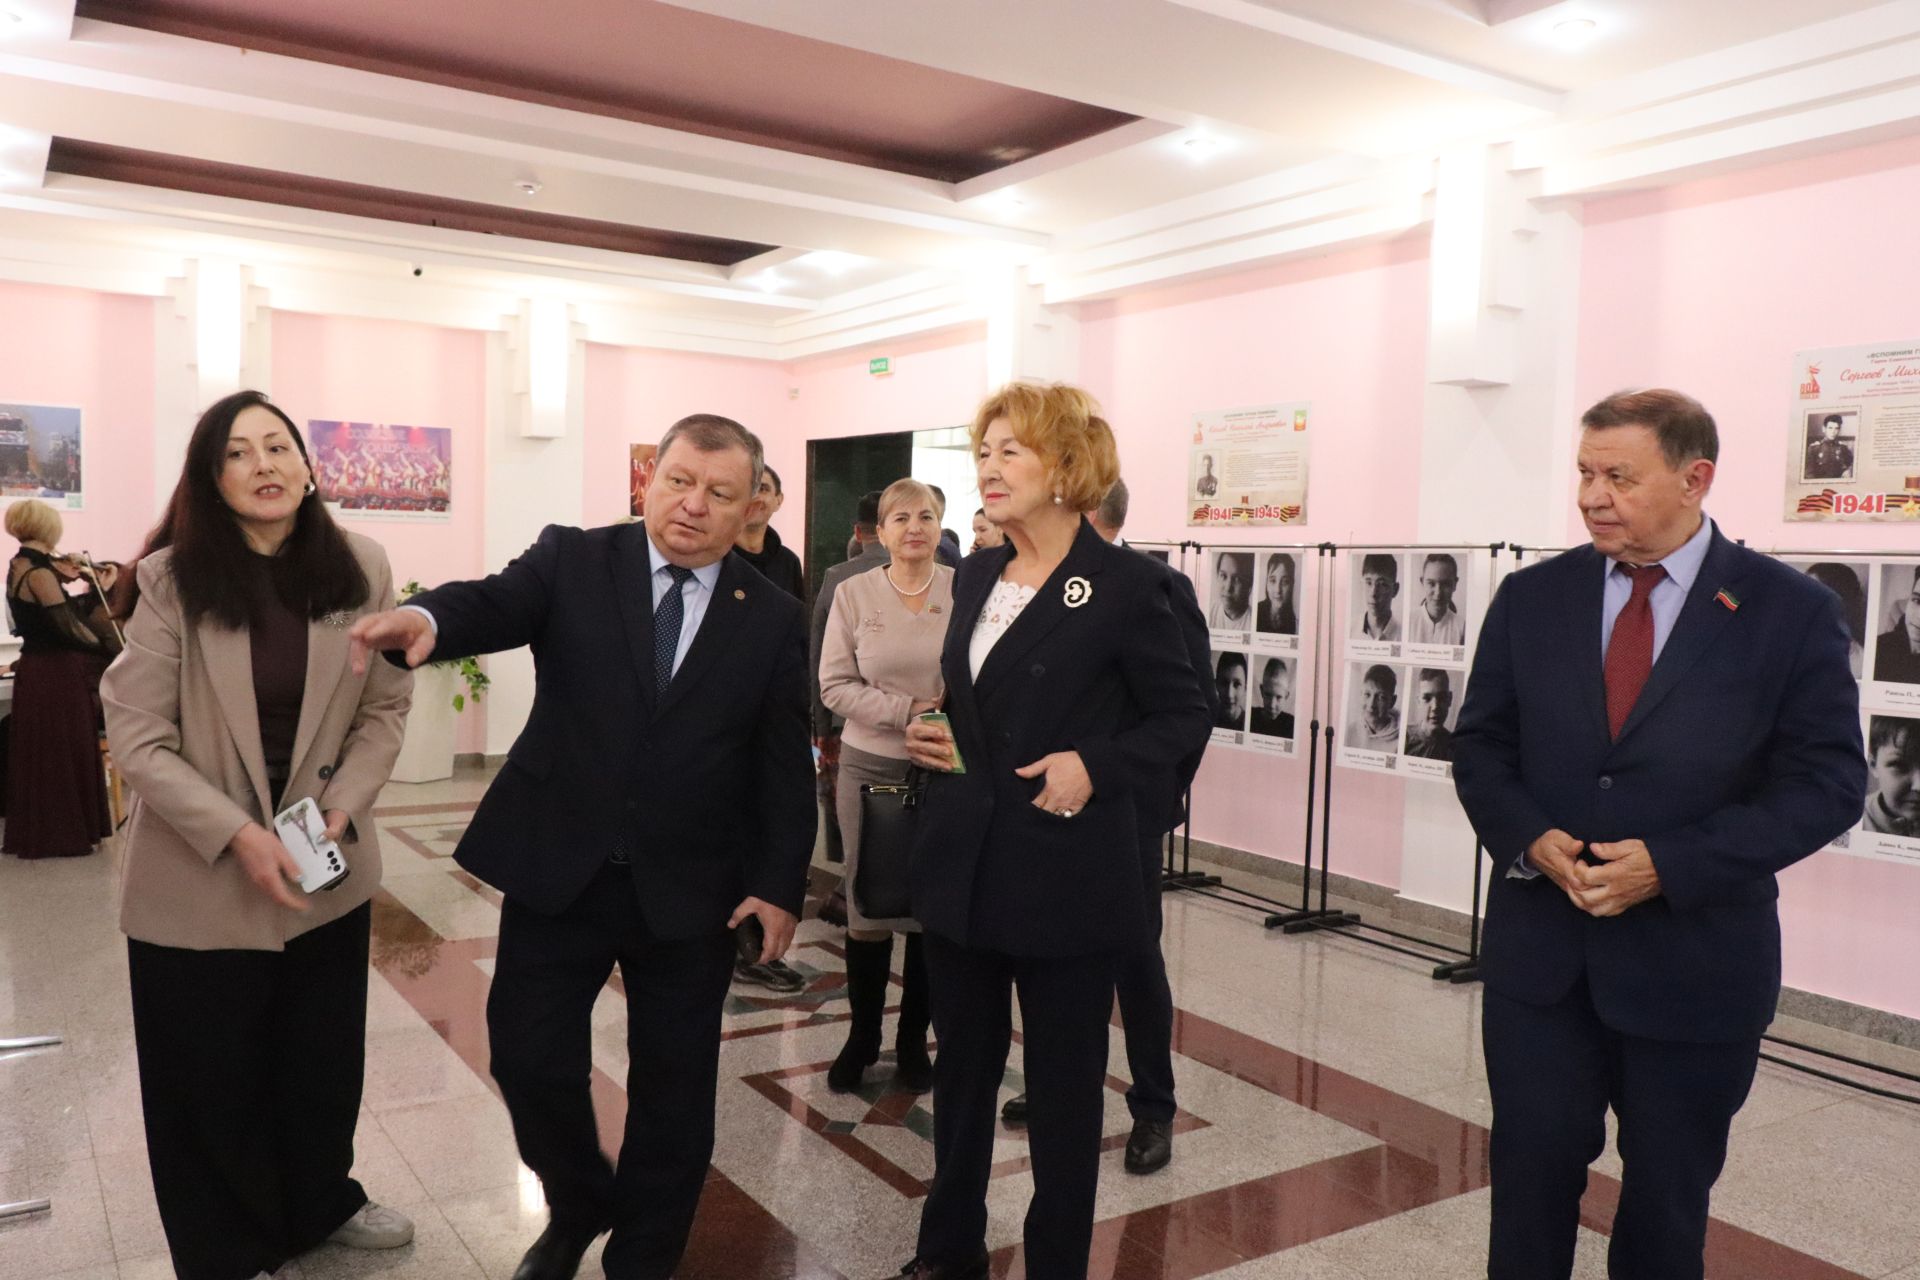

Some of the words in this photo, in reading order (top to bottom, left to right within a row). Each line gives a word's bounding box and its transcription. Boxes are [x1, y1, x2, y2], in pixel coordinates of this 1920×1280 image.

[1888, 364, 1920, 378] Мих
[1834, 494, 1884, 514] 1941
[1209, 507, 1232, 520] 1941
[1254, 506, 1280, 519] 1945
